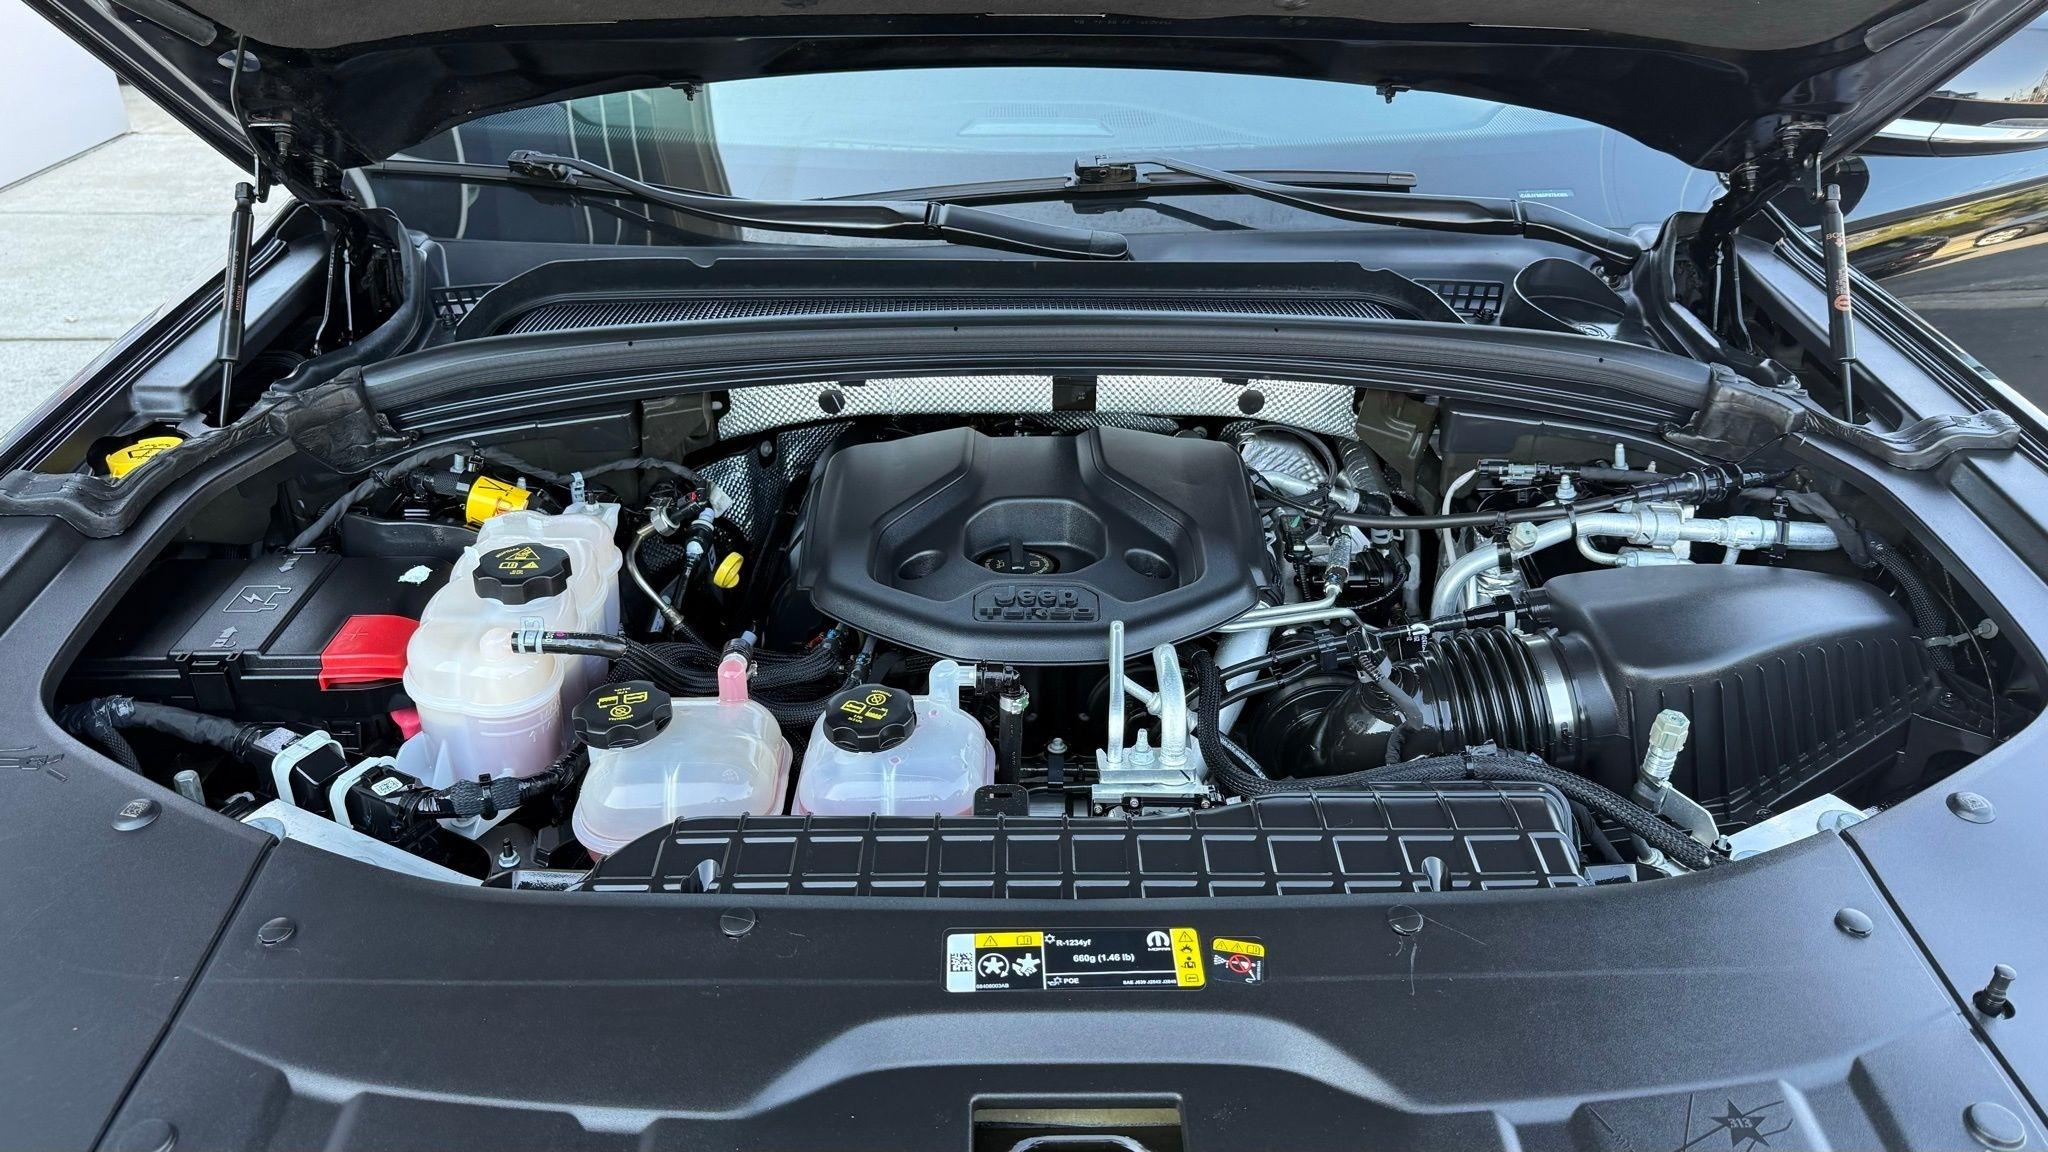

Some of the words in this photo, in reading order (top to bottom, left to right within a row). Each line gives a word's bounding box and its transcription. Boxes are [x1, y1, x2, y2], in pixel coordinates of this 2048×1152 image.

[995, 585, 1078, 607] Jeep
[1056, 939, 1091, 947] R-1234yf
[1073, 954, 1096, 964] 660g
[1098, 954, 1121, 963] (1.46
[1122, 954, 1135, 963] lb)
[1727, 1117, 1752, 1128] 313
